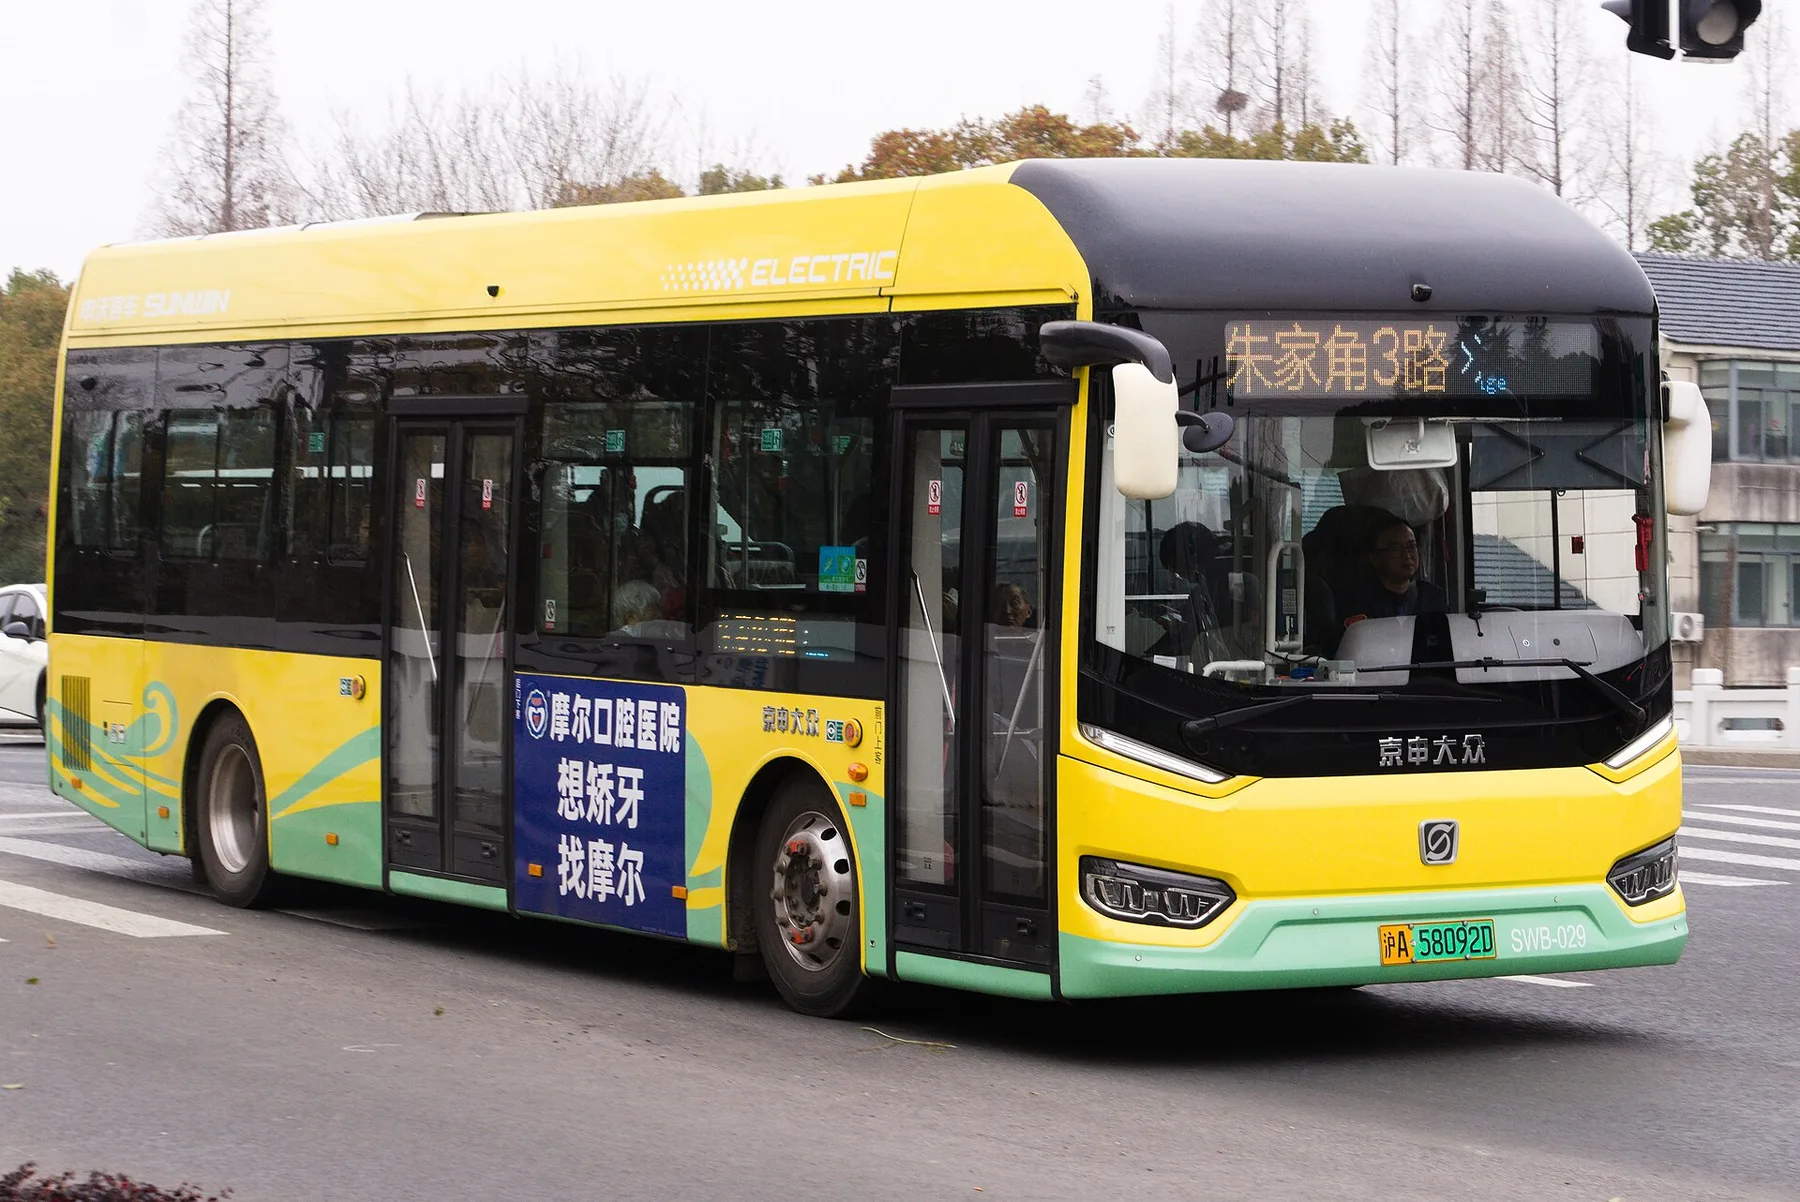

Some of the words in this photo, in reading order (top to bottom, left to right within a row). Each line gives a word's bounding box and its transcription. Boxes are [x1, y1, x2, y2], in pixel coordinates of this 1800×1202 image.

[751, 250, 897, 287] ELECTRIC
[142, 289, 230, 318] SUNWIN
[1225, 323, 1449, 393] 朱家角3路
[549, 691, 681, 754] 摩尔口腔医院
[762, 705, 820, 736] 京申大众
[1379, 733, 1486, 767] 京申大众
[557, 757, 645, 829] 想矫牙
[557, 833, 646, 906] 找摩尔
[1383, 929, 1410, 959] 沪A
[1419, 925, 1494, 957] 58092D
[1511, 924, 1586, 953] SWB-029
